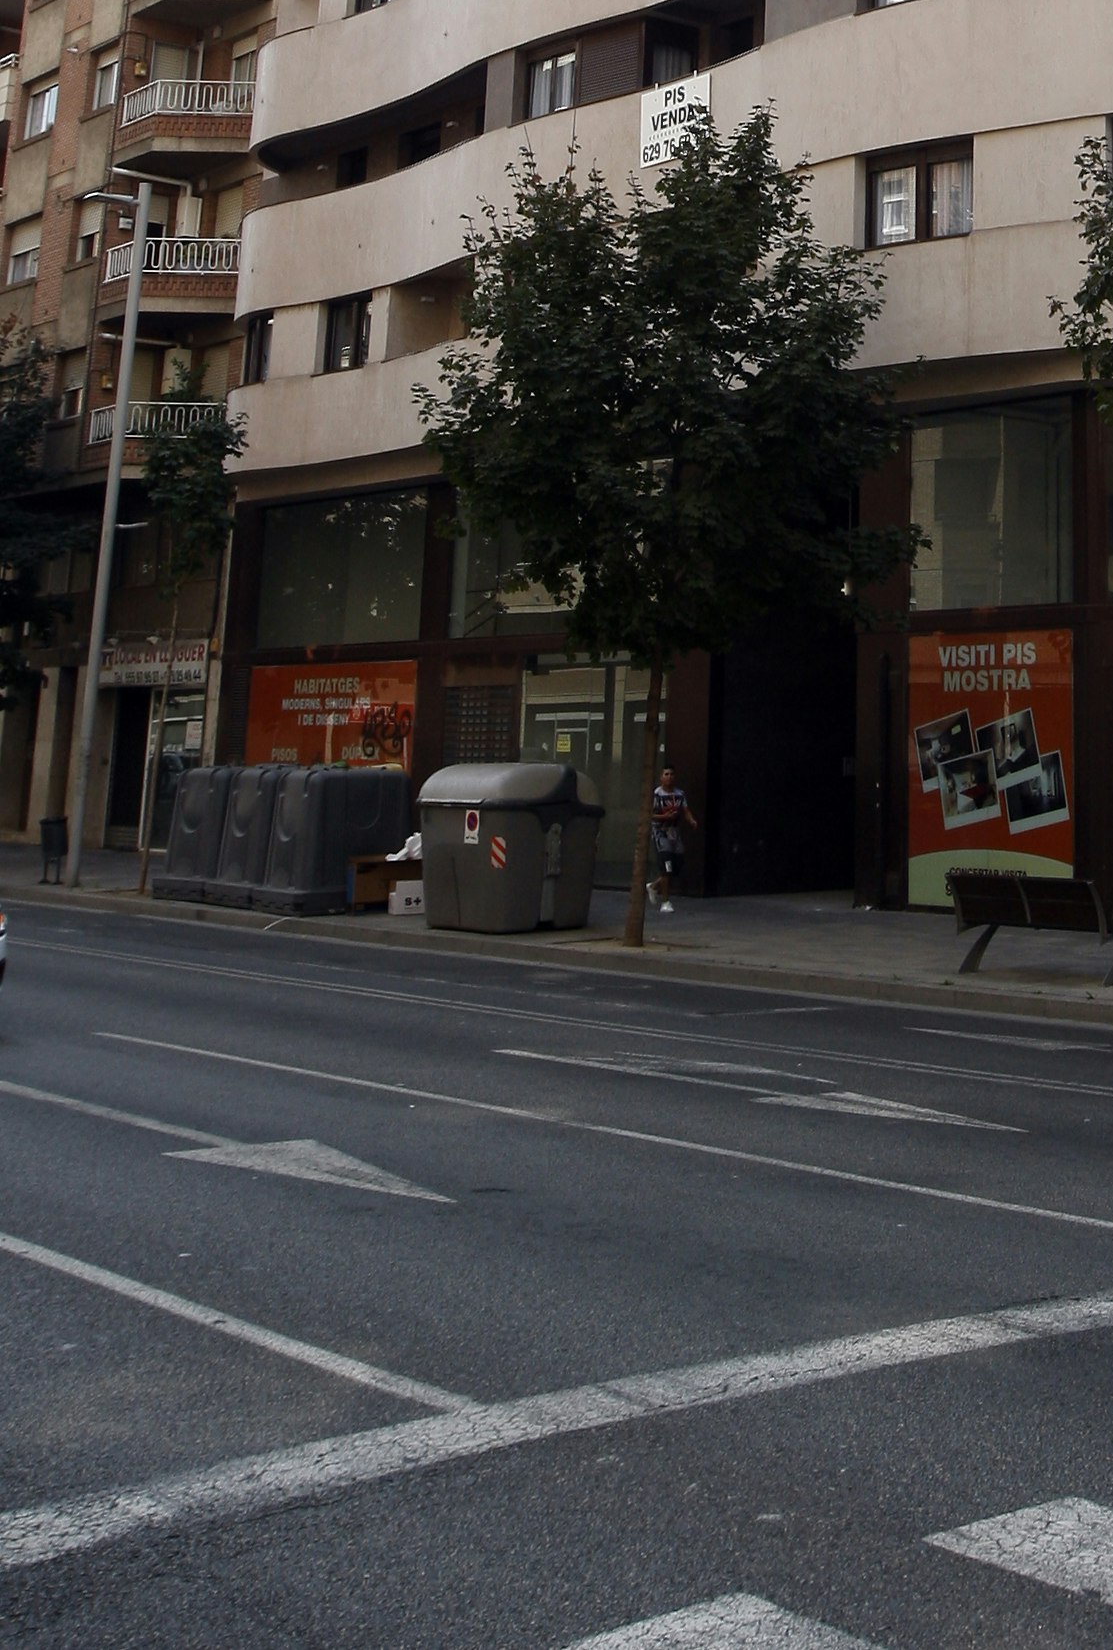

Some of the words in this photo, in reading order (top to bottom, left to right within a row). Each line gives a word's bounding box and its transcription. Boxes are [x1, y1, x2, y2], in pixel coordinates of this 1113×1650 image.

[664, 86, 685, 107] PIS
[643, 142, 661, 163] 629
[663, 138, 678, 158] 76
[159, 643, 205, 664] LLGUER
[938, 644, 996, 667] VISITI
[1002, 642, 1037, 665] PIS
[294, 677, 361, 694] HABITATGES
[943, 668, 1032, 692] MOSTRA
[282, 698, 323, 711] MODERNS,
[297, 714, 302, 726] I
[303, 714, 313, 726] DE
[271, 748, 298, 762] PISOS
